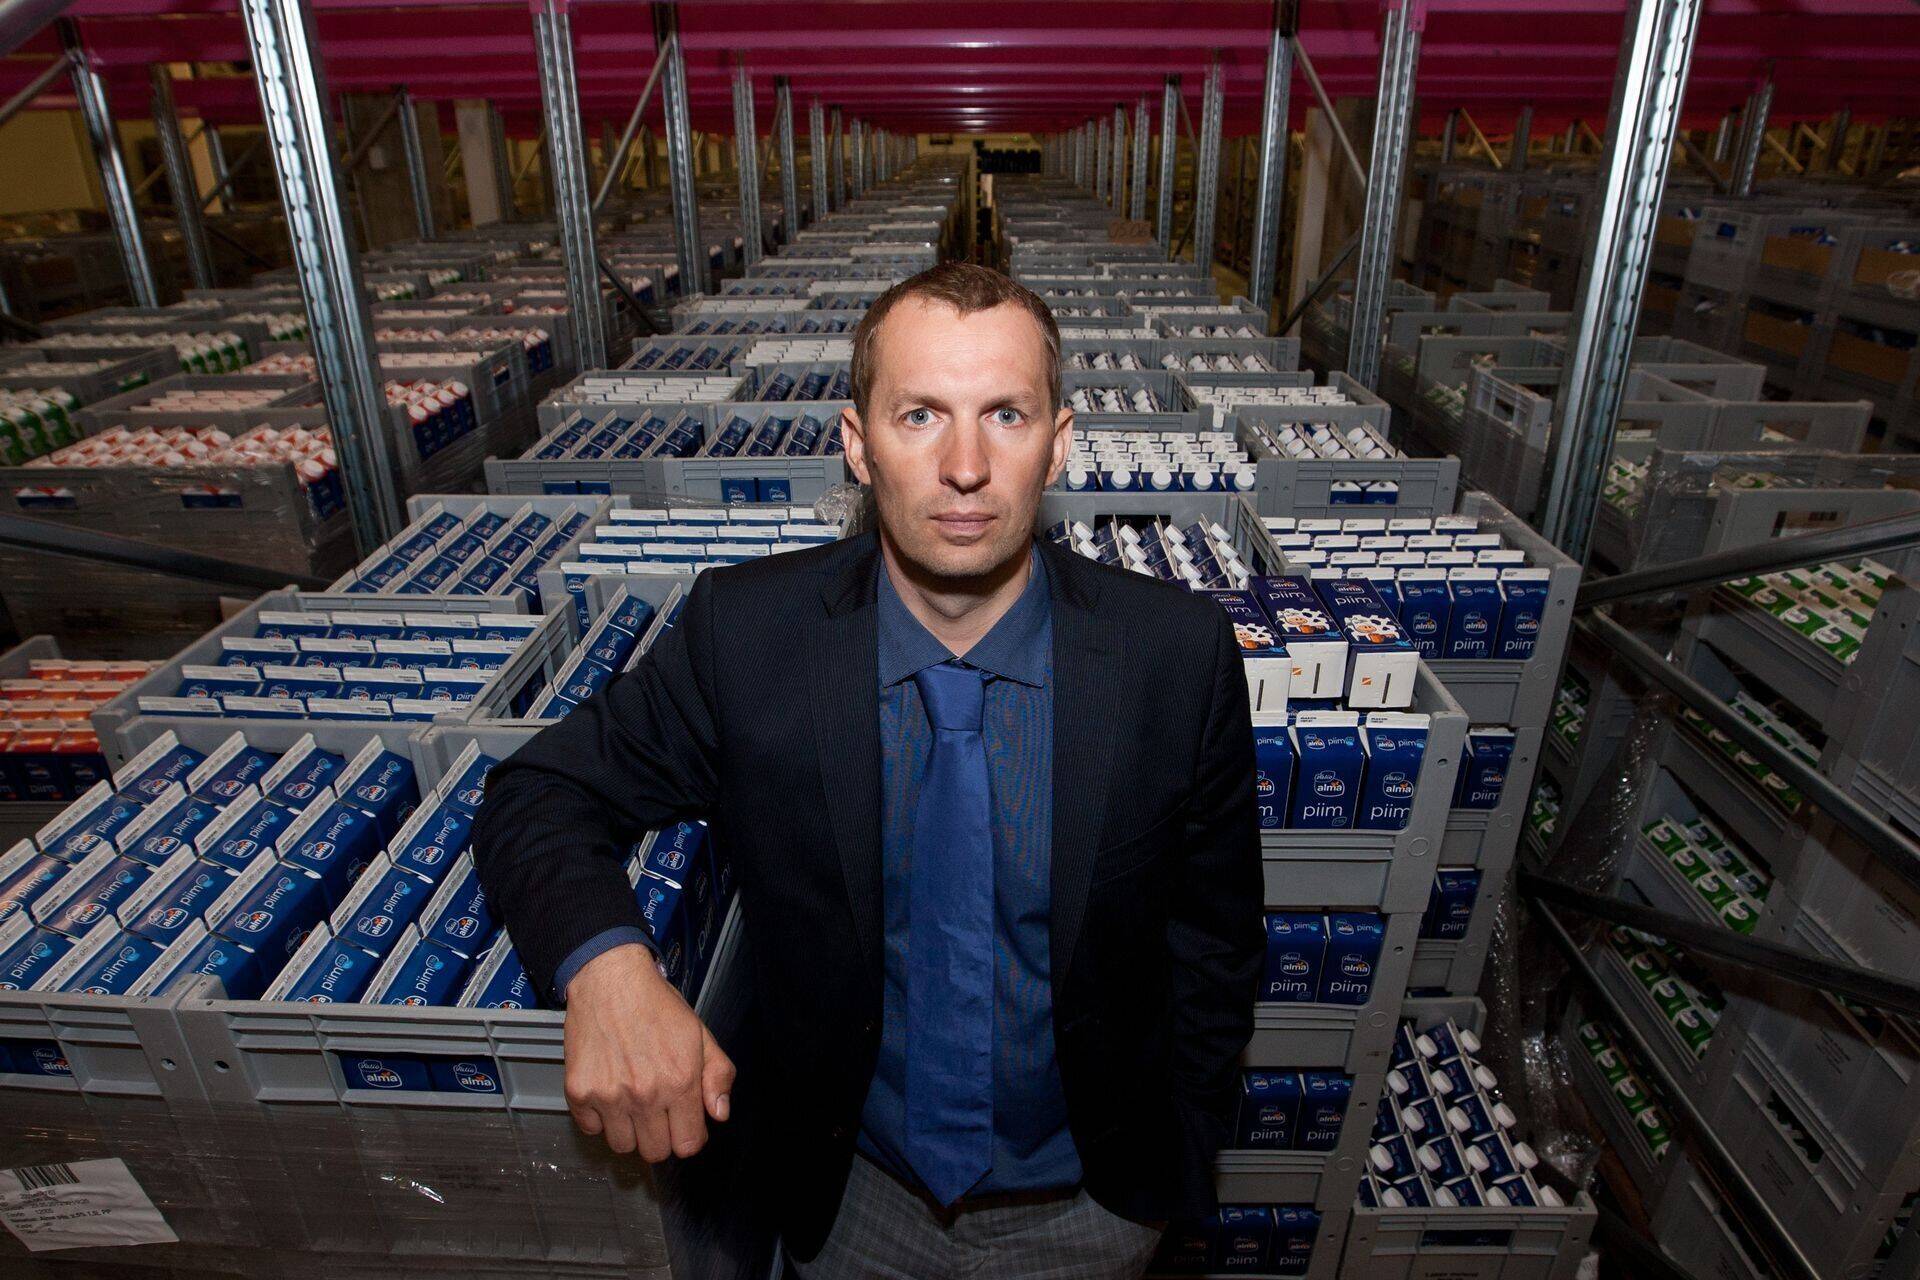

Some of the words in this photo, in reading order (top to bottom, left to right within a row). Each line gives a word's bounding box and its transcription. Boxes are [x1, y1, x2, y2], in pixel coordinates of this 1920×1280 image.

[1269, 591, 1306, 601] piim
[1335, 596, 1373, 606] piim
[1225, 606, 1252, 614] iim
[1414, 638, 1435, 650] iim
[1454, 638, 1485, 652] piim
[1257, 735, 1275, 747] piim
[1328, 736, 1346, 747] piim
[1257, 784, 1272, 792] ma
[1317, 783, 1343, 792] alma
[1386, 784, 1412, 794] alma
[1303, 803, 1343, 820] piim
[1370, 804, 1411, 820] piim
[173, 816, 194, 835] piim
[250, 818, 271, 838] piim
[326, 822, 346, 841] piim
[435, 825, 452, 845] piim
[674, 832, 687, 850] piim
[98, 880, 123, 901] piim
[180, 881, 203, 906] piim
[264, 886, 287, 909] piim
[384, 889, 405, 913] piim
[80, 904, 101, 923] alma
[163, 909, 183, 928] alma
[644, 900, 658, 921] piim
[249, 912, 268, 930] alma
[372, 916, 389, 937] alma
[459, 917, 474, 937] alma
[11, 954, 40, 979] piim
[101, 958, 128, 983] piim
[197, 962, 217, 977] im
[1283, 962, 1307, 971] alma
[1344, 963, 1368, 973] alma
[321, 967, 345, 991] piim
[415, 966, 434, 992] piim
[510, 972, 527, 997] piim
[1270, 979, 1308, 993] piim
[1330, 980, 1368, 994] piim
[43, 1060, 71, 1071] alma
[366, 1073, 398, 1083] alma
[461, 1076, 492, 1087] alma
[1251, 1129, 1285, 1141] piim
[1226, 1256, 1258, 1266] piim
